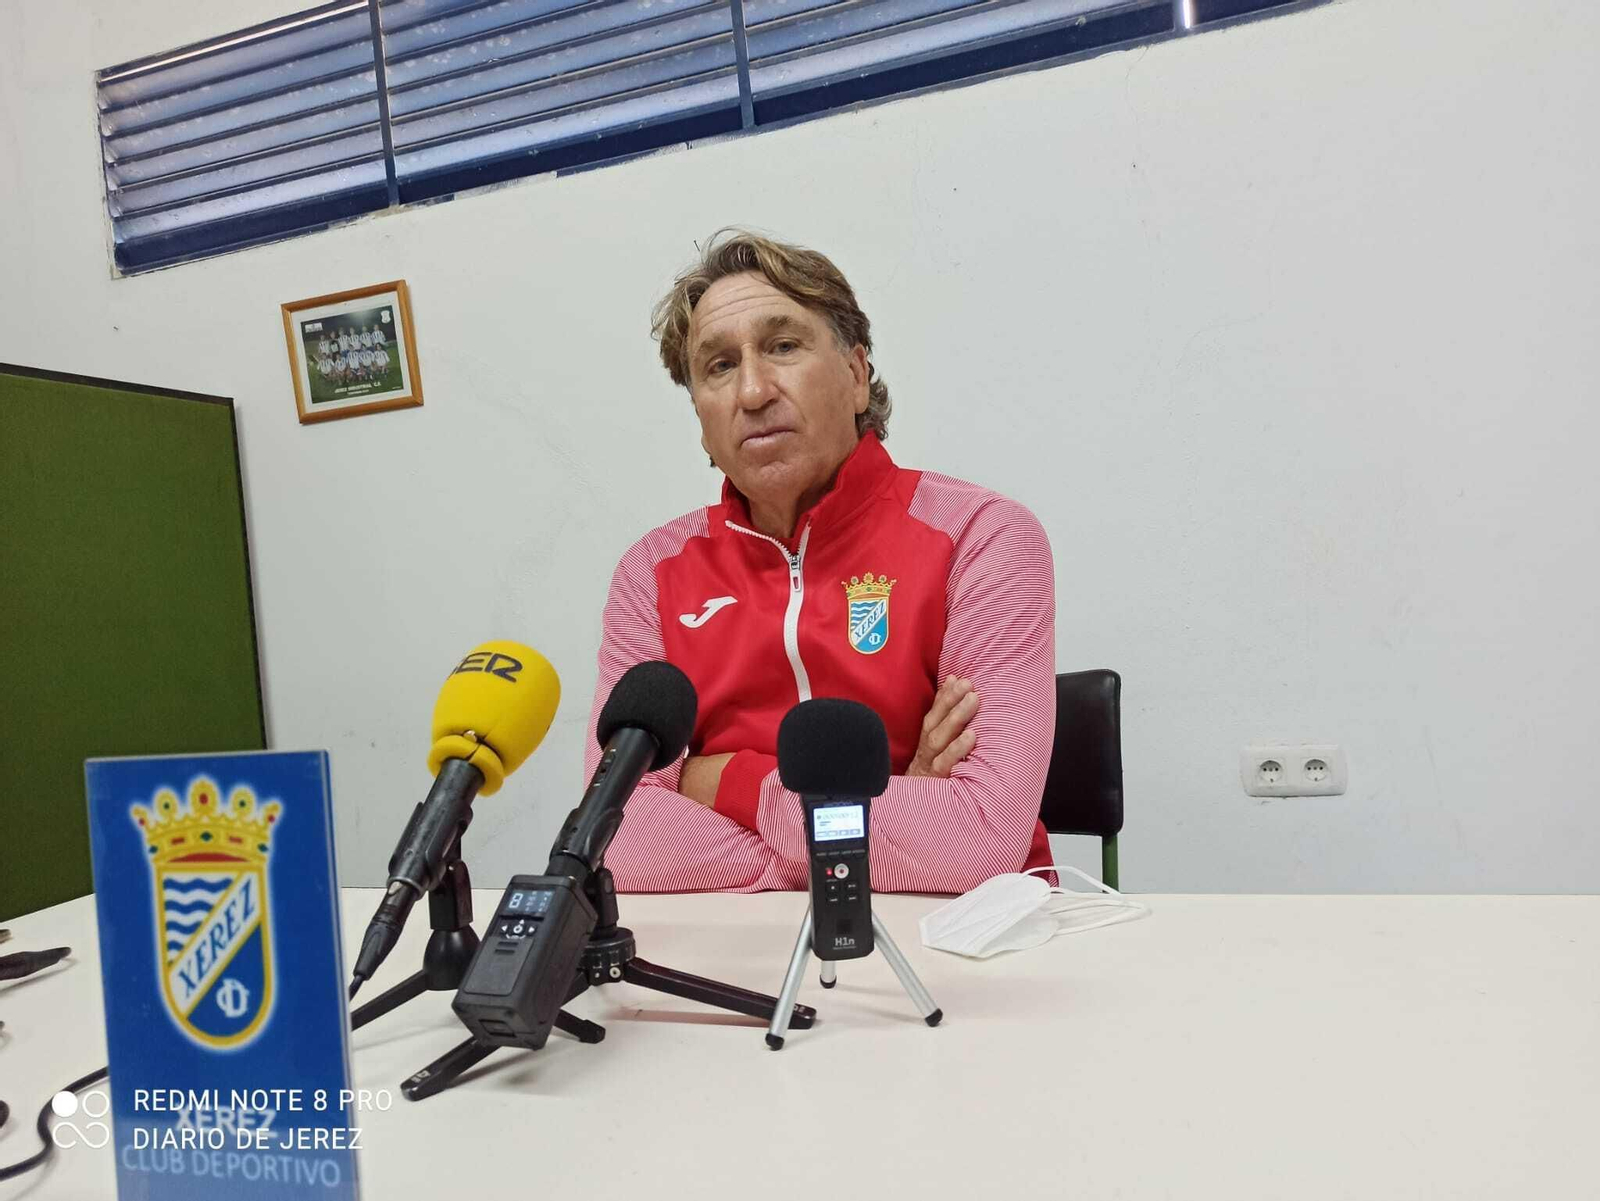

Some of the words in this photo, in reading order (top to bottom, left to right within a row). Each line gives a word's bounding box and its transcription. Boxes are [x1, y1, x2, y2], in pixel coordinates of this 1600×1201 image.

[447, 652, 523, 683] ER
[179, 880, 254, 998] XEREZ
[835, 937, 855, 947] H1n
[121, 1144, 187, 1176] CLUB
[193, 1148, 341, 1188] DEPORTIVO
